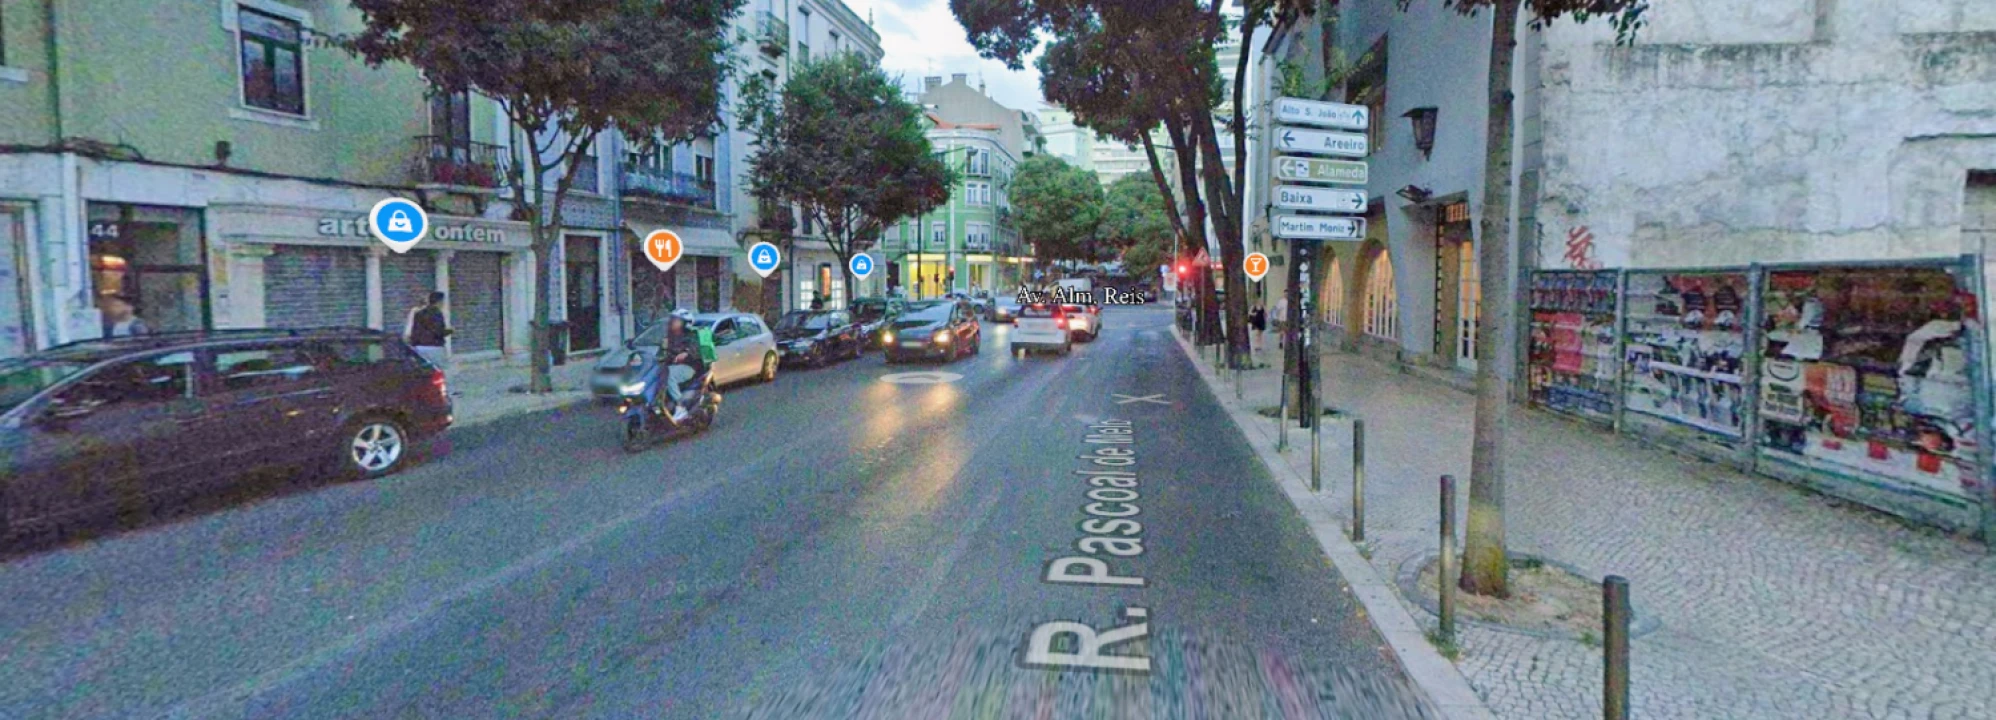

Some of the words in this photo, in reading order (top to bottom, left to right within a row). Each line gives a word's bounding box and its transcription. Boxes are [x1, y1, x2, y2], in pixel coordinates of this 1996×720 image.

[1282, 104, 1300, 114] Alto
[1324, 136, 1365, 150] Areeiro
[1317, 164, 1365, 178] Alameda
[1281, 191, 1313, 204] Baixa
[91, 224, 119, 238] 44
[319, 216, 372, 236] art
[435, 223, 506, 242] ontem
[1282, 221, 1314, 232] Martim
[1320, 223, 1345, 233] Moniz
